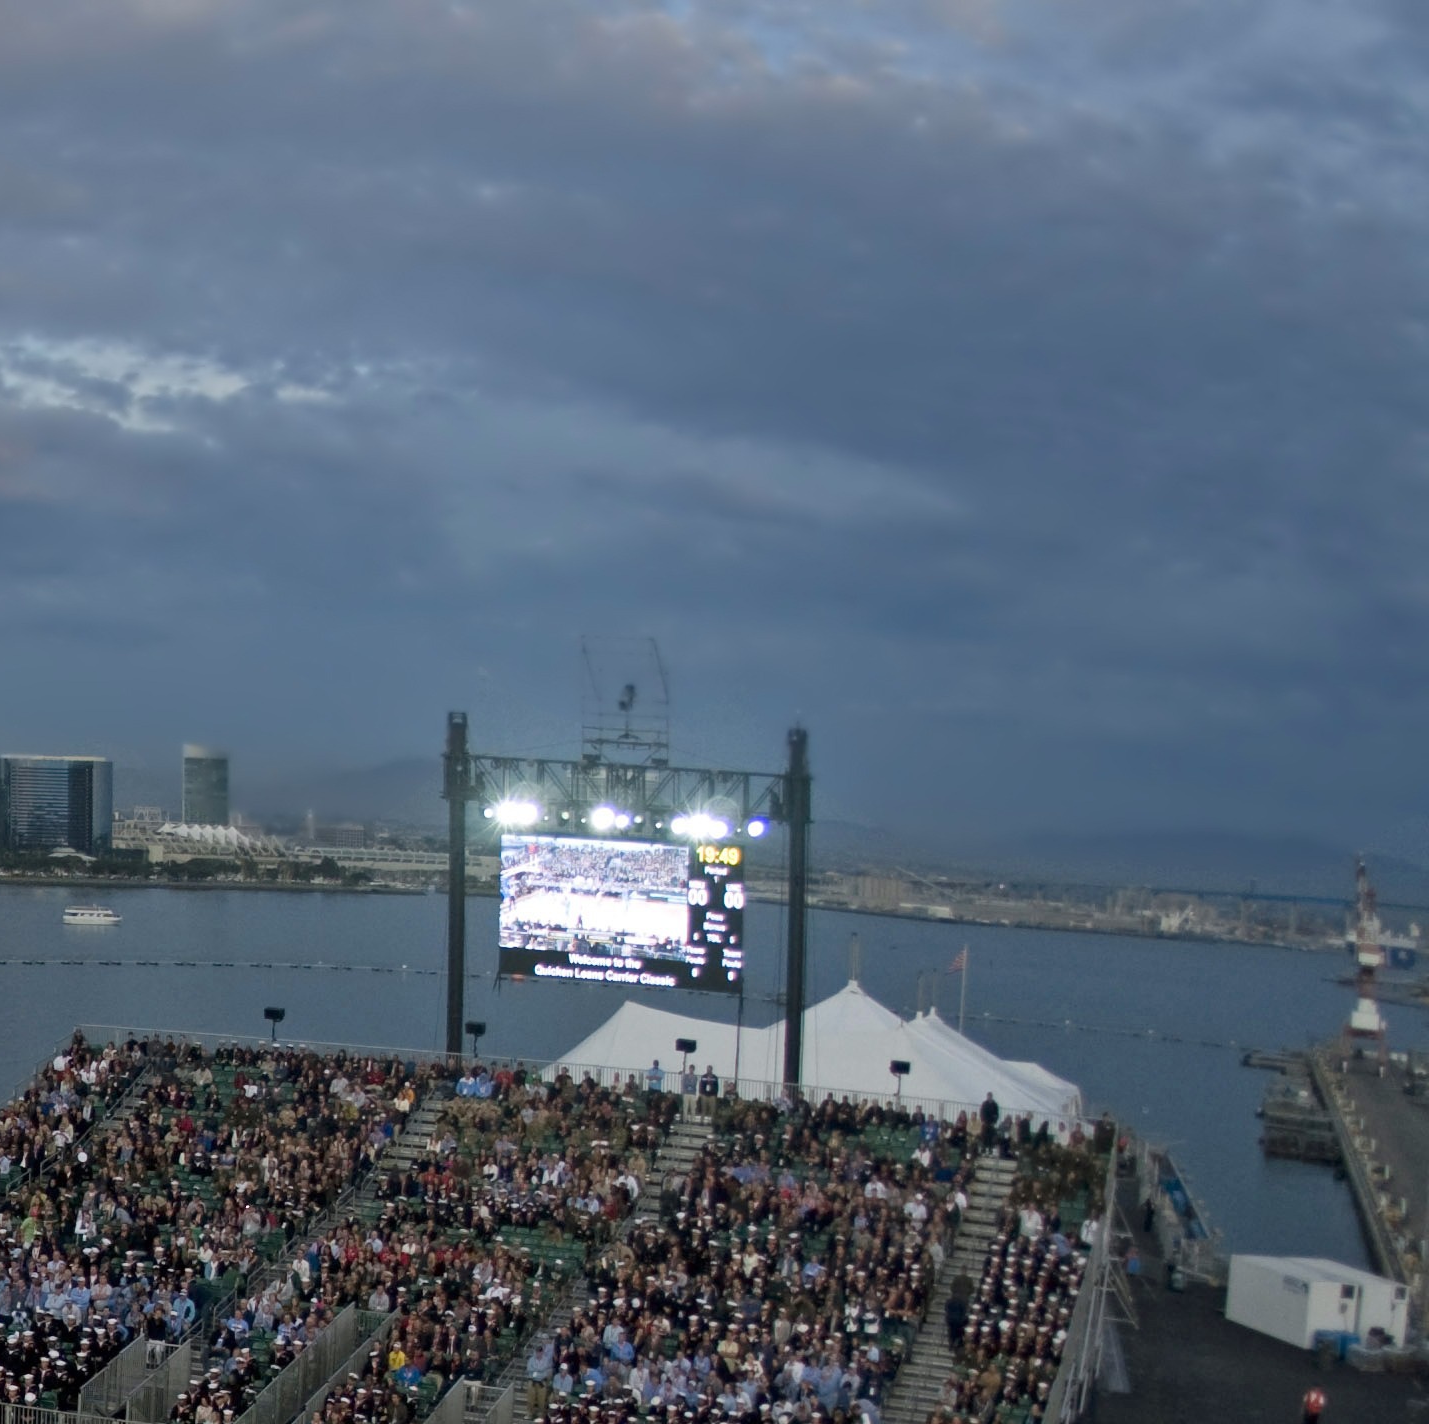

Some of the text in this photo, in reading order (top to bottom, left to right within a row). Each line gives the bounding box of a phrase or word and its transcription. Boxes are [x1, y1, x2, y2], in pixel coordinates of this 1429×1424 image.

[697, 846, 740, 865] 19:49
[569, 953, 640, 970] Welcome to the
[535, 964, 675, 986] Quicken Loans Carrier Classic
